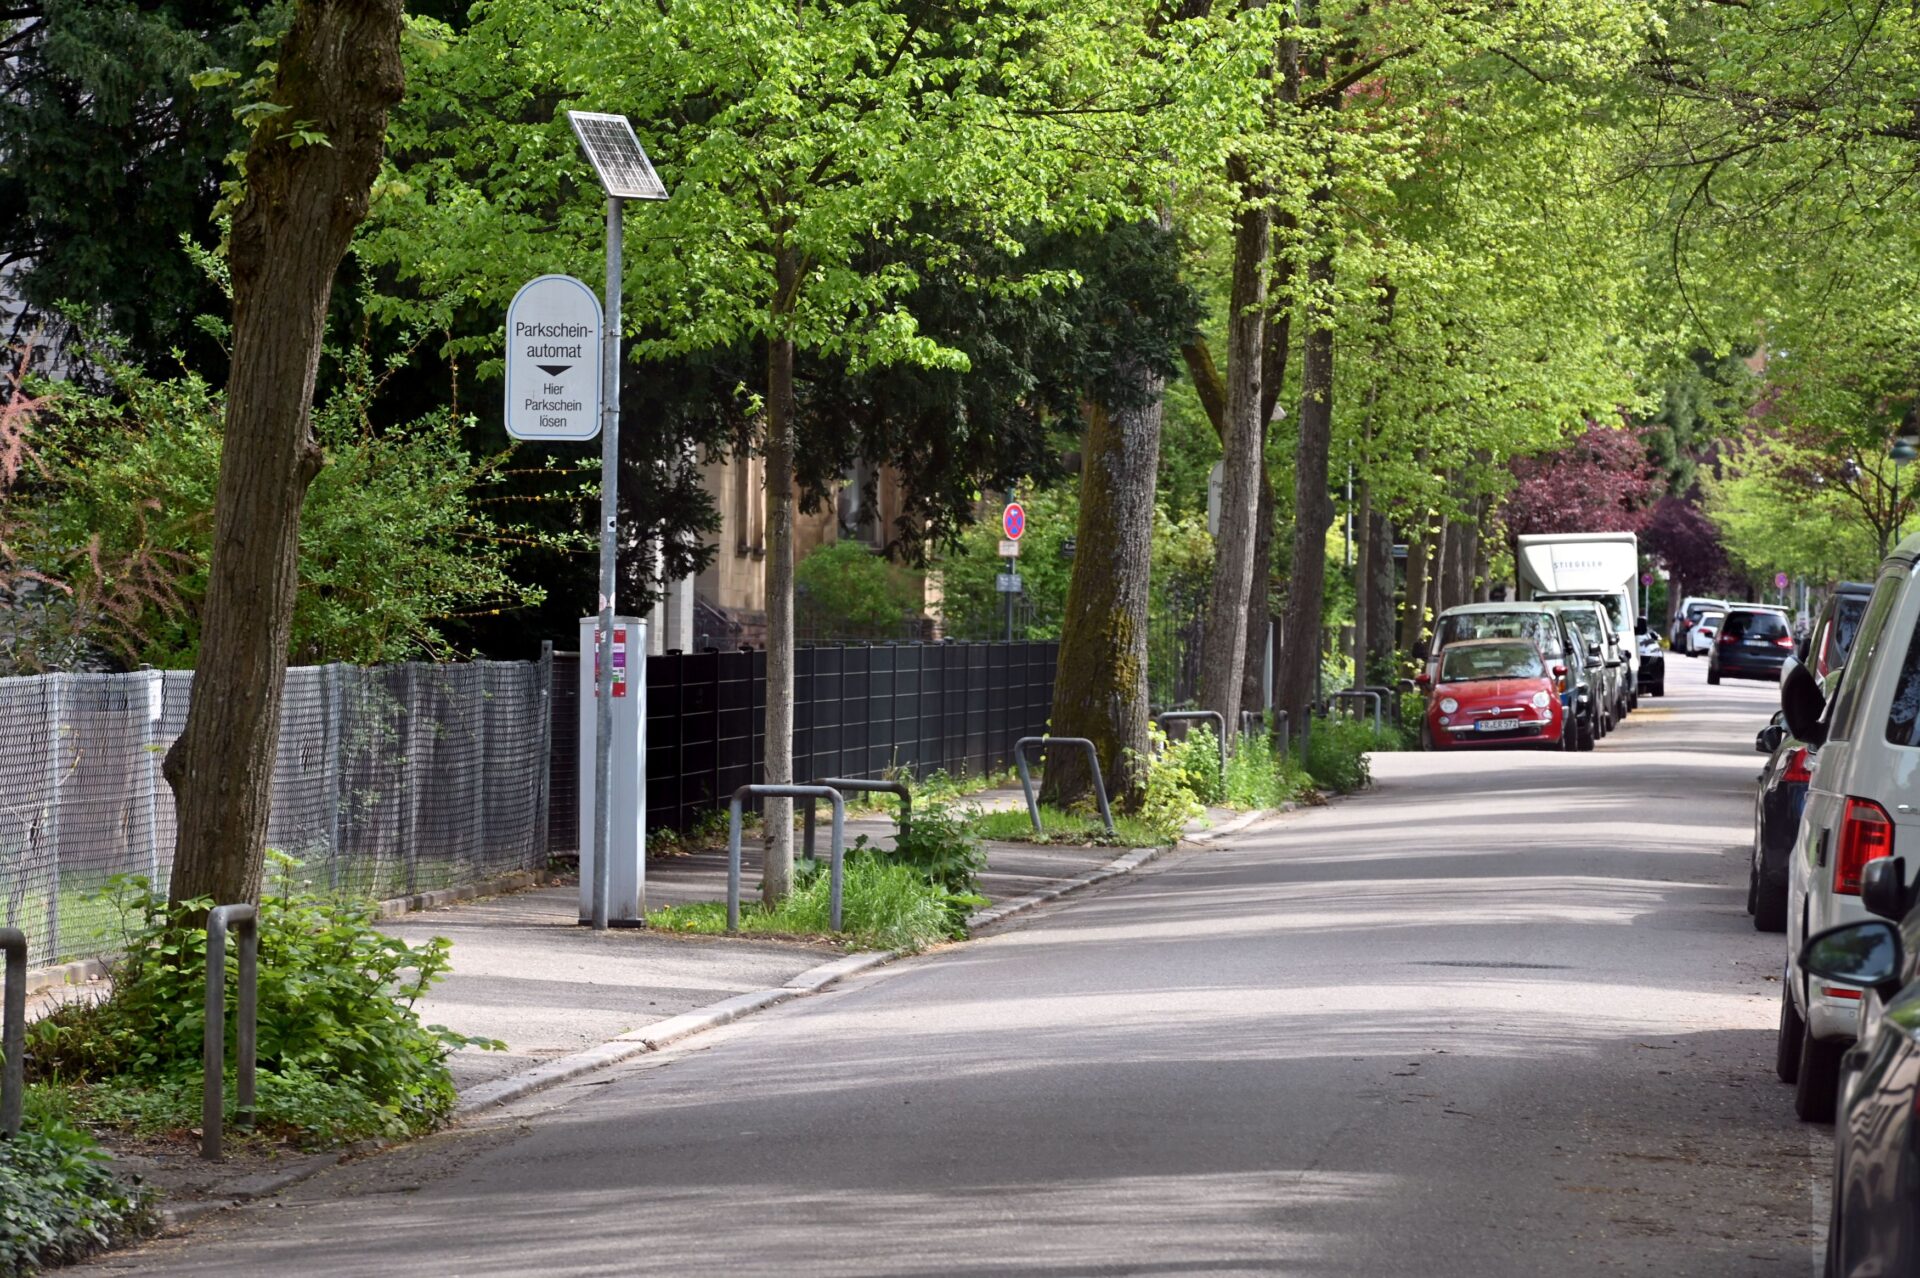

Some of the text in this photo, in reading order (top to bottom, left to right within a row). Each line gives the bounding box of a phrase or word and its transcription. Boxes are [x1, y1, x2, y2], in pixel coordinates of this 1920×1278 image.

[516, 322, 593, 337] Parkschein-
[527, 344, 582, 358] automat
[543, 383, 564, 395] Hier
[525, 399, 582, 411] Parkschein
[539, 415, 567, 427] lösen
